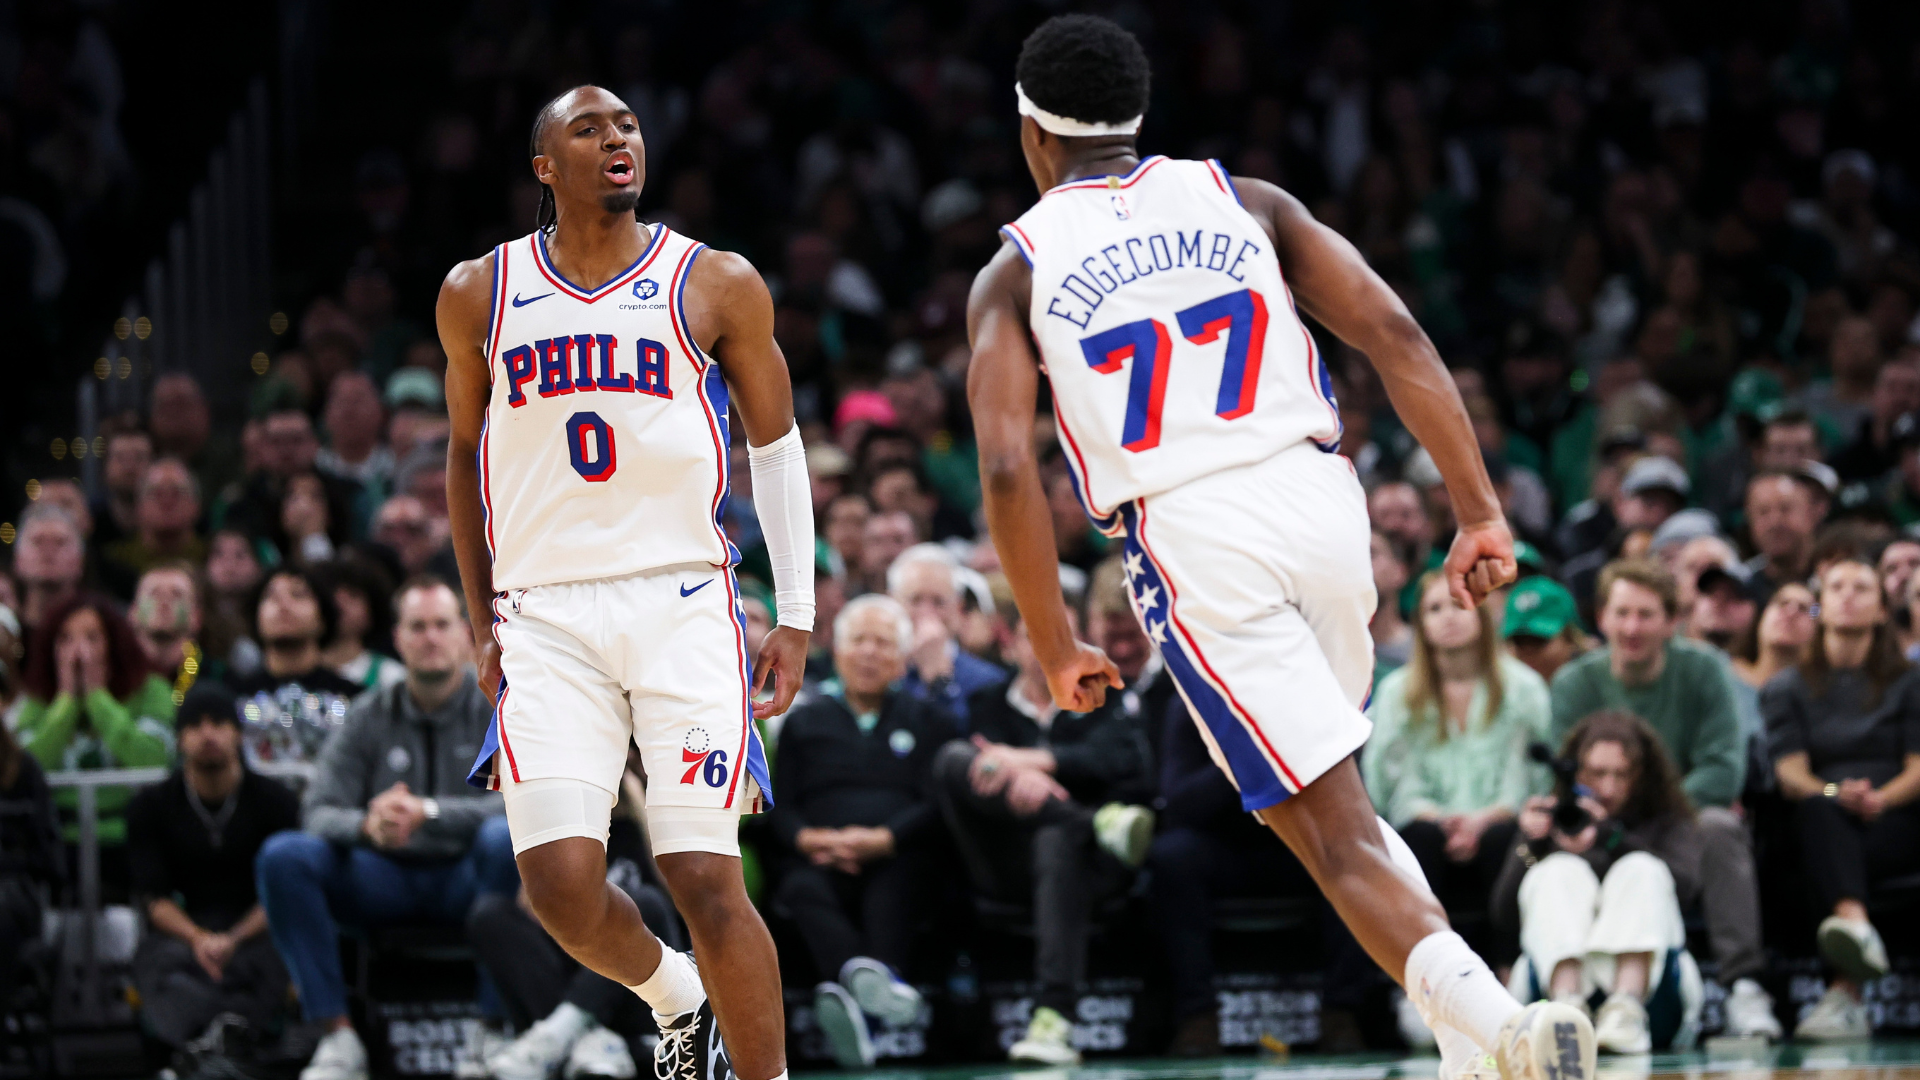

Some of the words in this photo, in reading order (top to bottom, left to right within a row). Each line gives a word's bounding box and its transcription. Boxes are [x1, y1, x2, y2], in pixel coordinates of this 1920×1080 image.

[1047, 230, 1260, 330] EDGECOMBE
[502, 333, 673, 409] PHILA
[1079, 288, 1269, 453] 77
[566, 411, 617, 482] 0
[680, 746, 728, 788] 76
